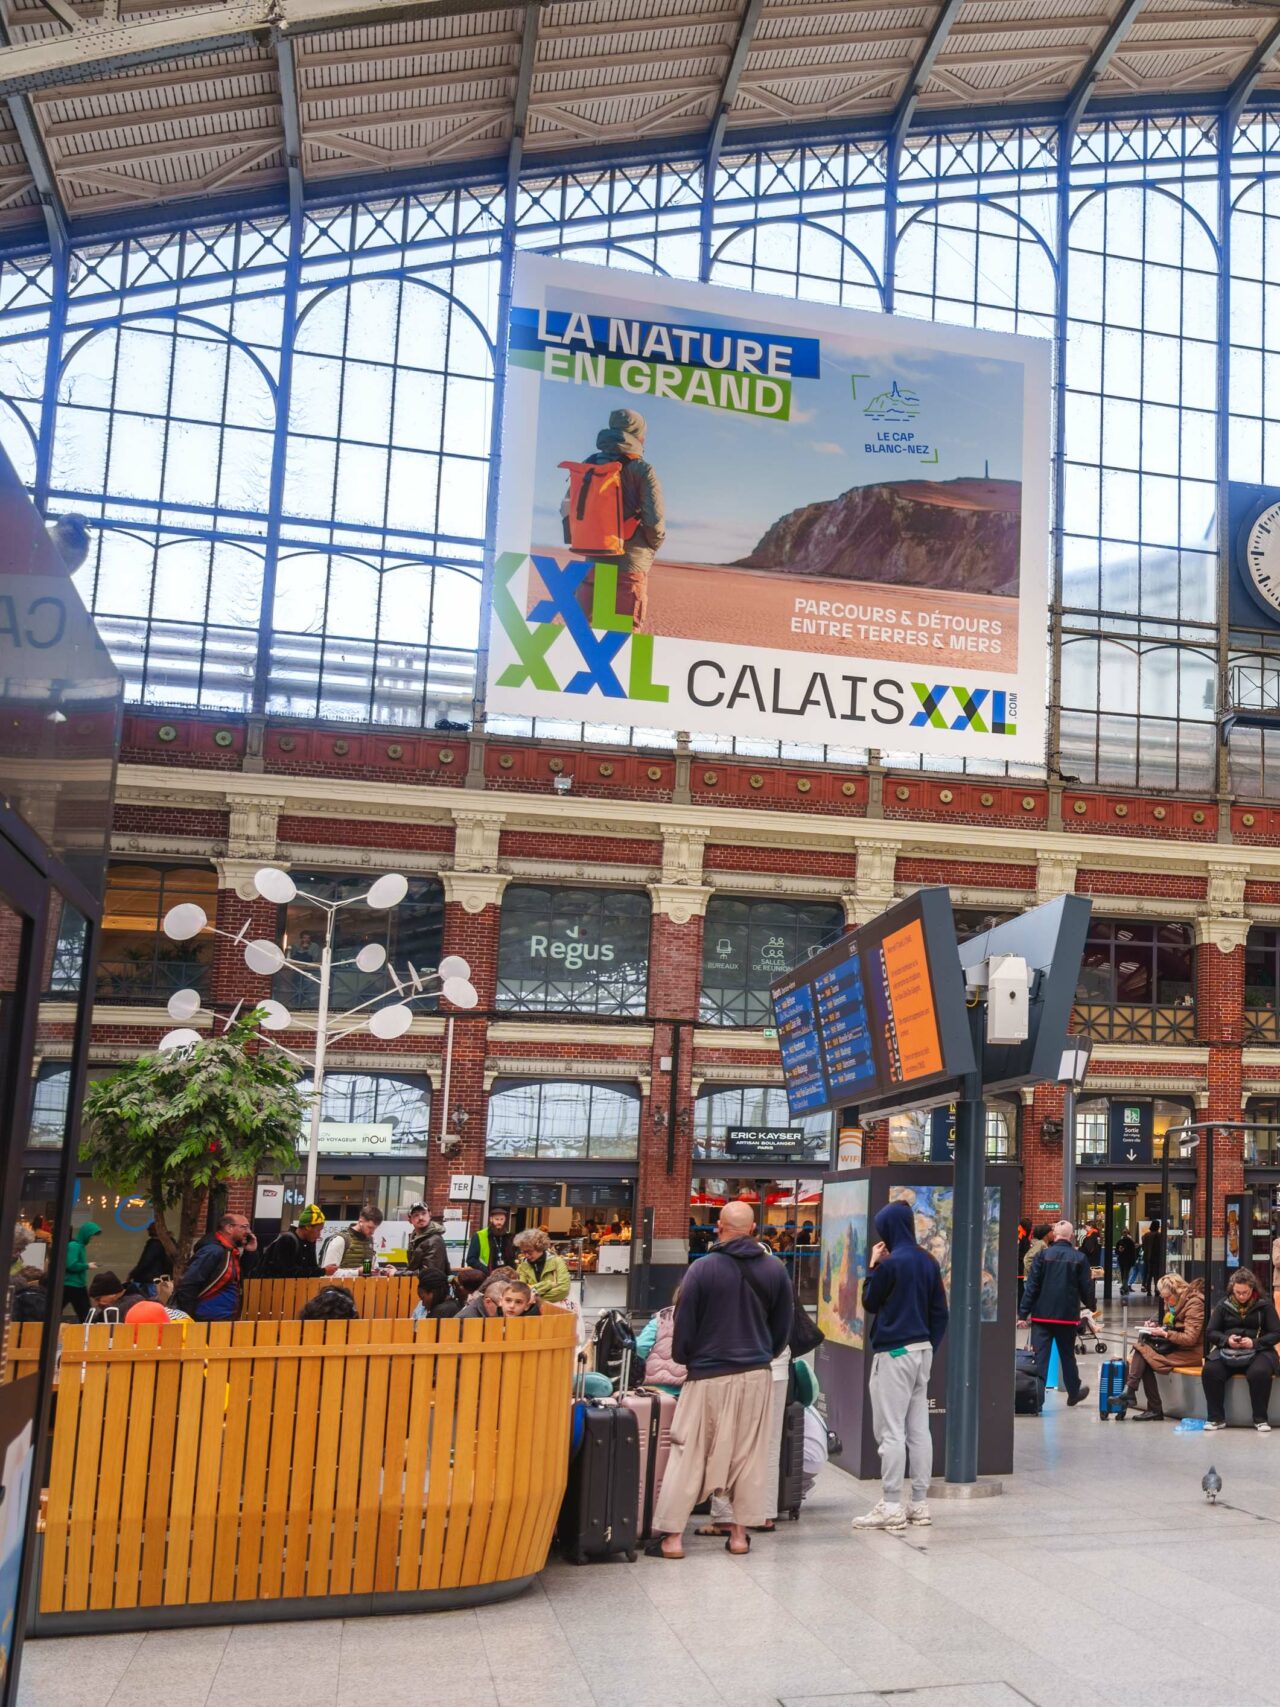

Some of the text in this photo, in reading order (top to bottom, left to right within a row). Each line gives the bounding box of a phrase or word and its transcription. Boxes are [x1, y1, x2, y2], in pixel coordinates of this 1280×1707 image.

[537, 308, 794, 379] LA NATURE
[543, 347, 786, 416] EN GRAND
[877, 432, 915, 442] LE CAP
[864, 443, 930, 455] BLANC-NEZ
[794, 598, 1002, 635] PARCOURS & DÉTOURS
[790, 616, 1002, 654] ENTRE TERRES & MERS
[530, 935, 615, 970] Regus
[707, 962, 739, 970] BUREAUX
[760, 958, 786, 966] SALLES
[730, 1131, 802, 1141] ERIC KAYSER
[453, 1182, 469, 1191] TER
